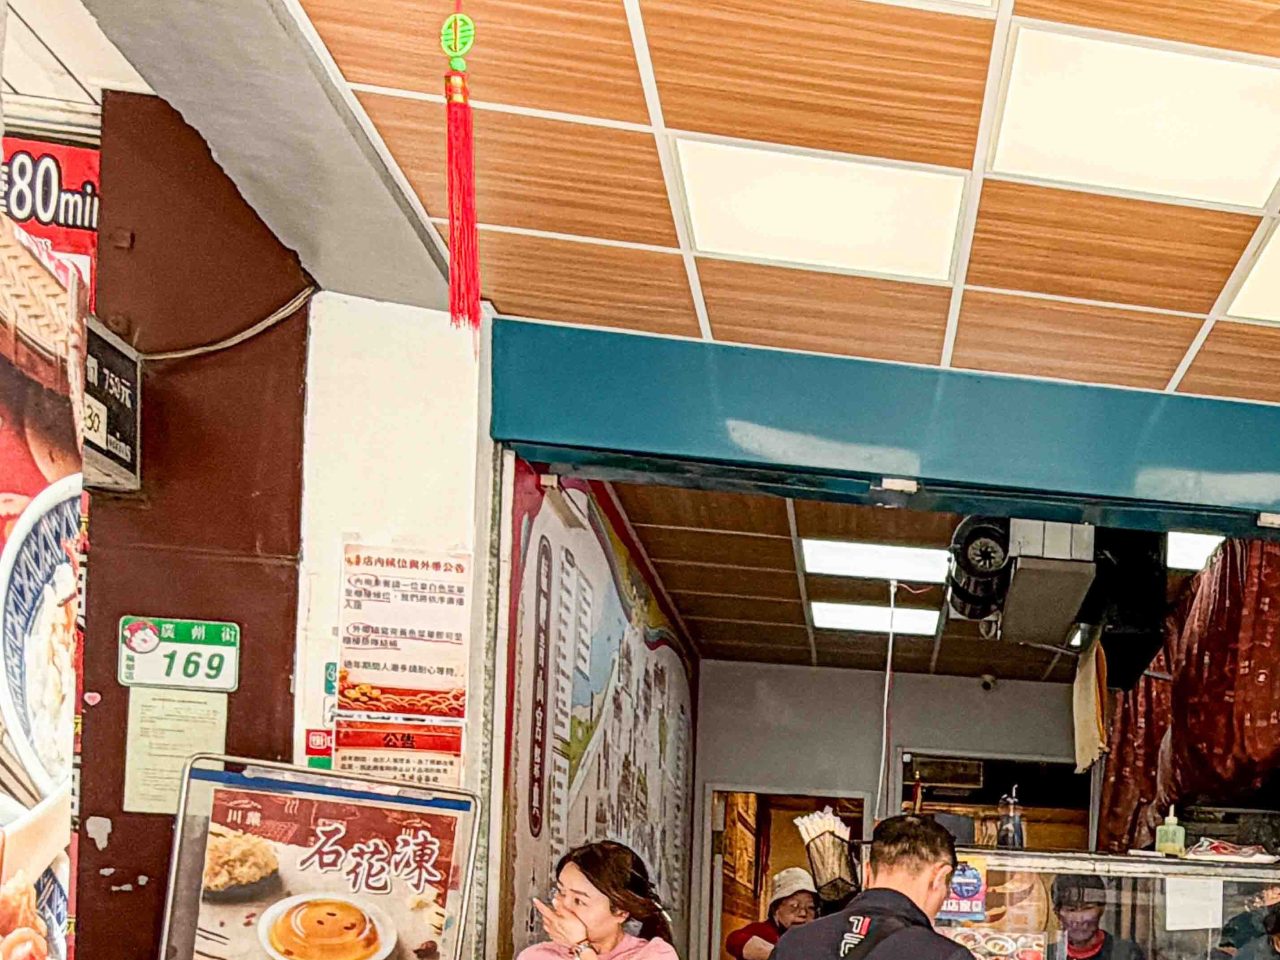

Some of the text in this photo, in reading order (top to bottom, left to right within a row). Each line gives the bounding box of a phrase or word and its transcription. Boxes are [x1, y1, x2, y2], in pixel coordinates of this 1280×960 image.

[160, 623, 236, 644] 廣州街
[162, 650, 226, 680] 169
[226, 808, 263, 828] 川業
[299, 821, 443, 894] 石花凍
